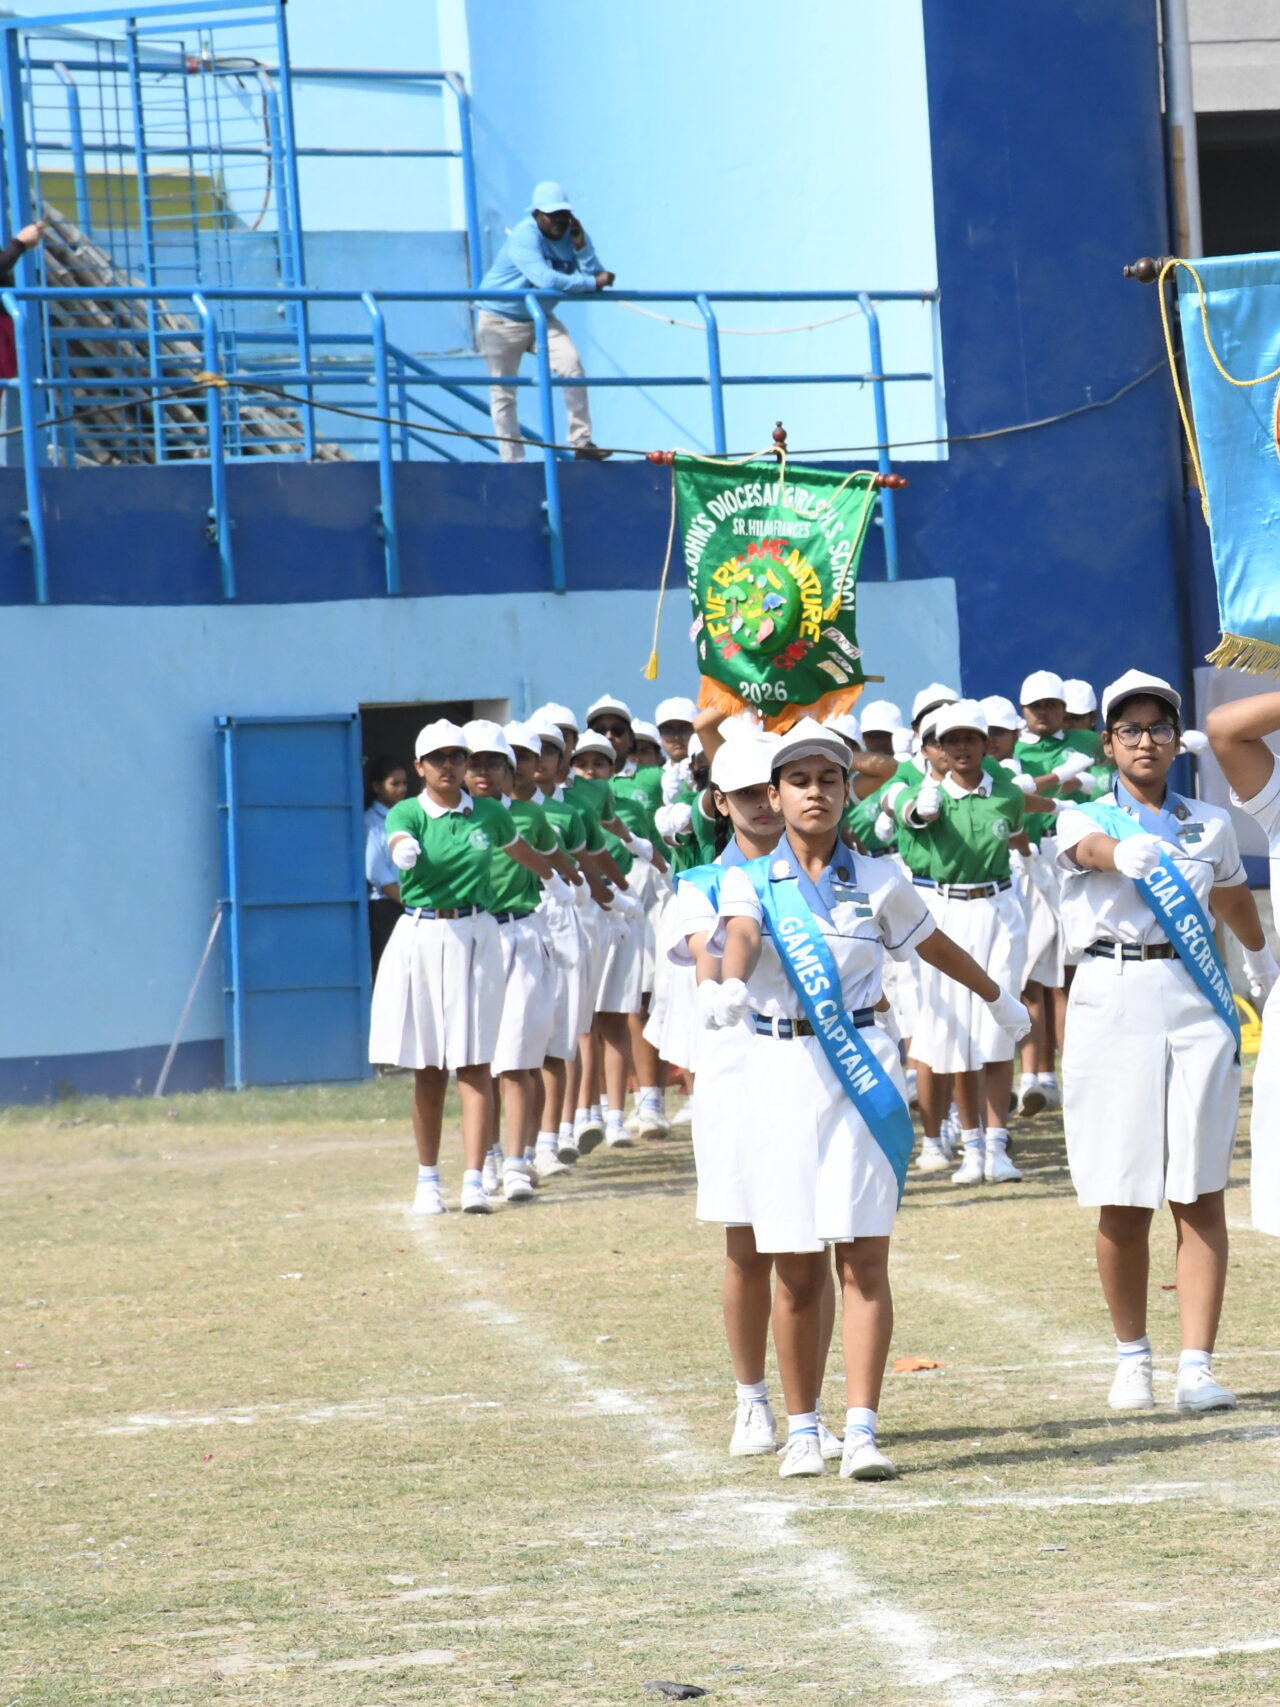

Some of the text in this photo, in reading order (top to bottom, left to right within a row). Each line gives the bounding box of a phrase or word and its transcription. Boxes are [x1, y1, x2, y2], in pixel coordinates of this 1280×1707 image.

[684, 512, 717, 577] JOHN'S
[783, 548, 822, 644] NATURE
[739, 680, 788, 704] 2026
[1144, 866, 1236, 1017] CIAL SECRETARY
[778, 916, 879, 1097] GAMES CAPTAIN
